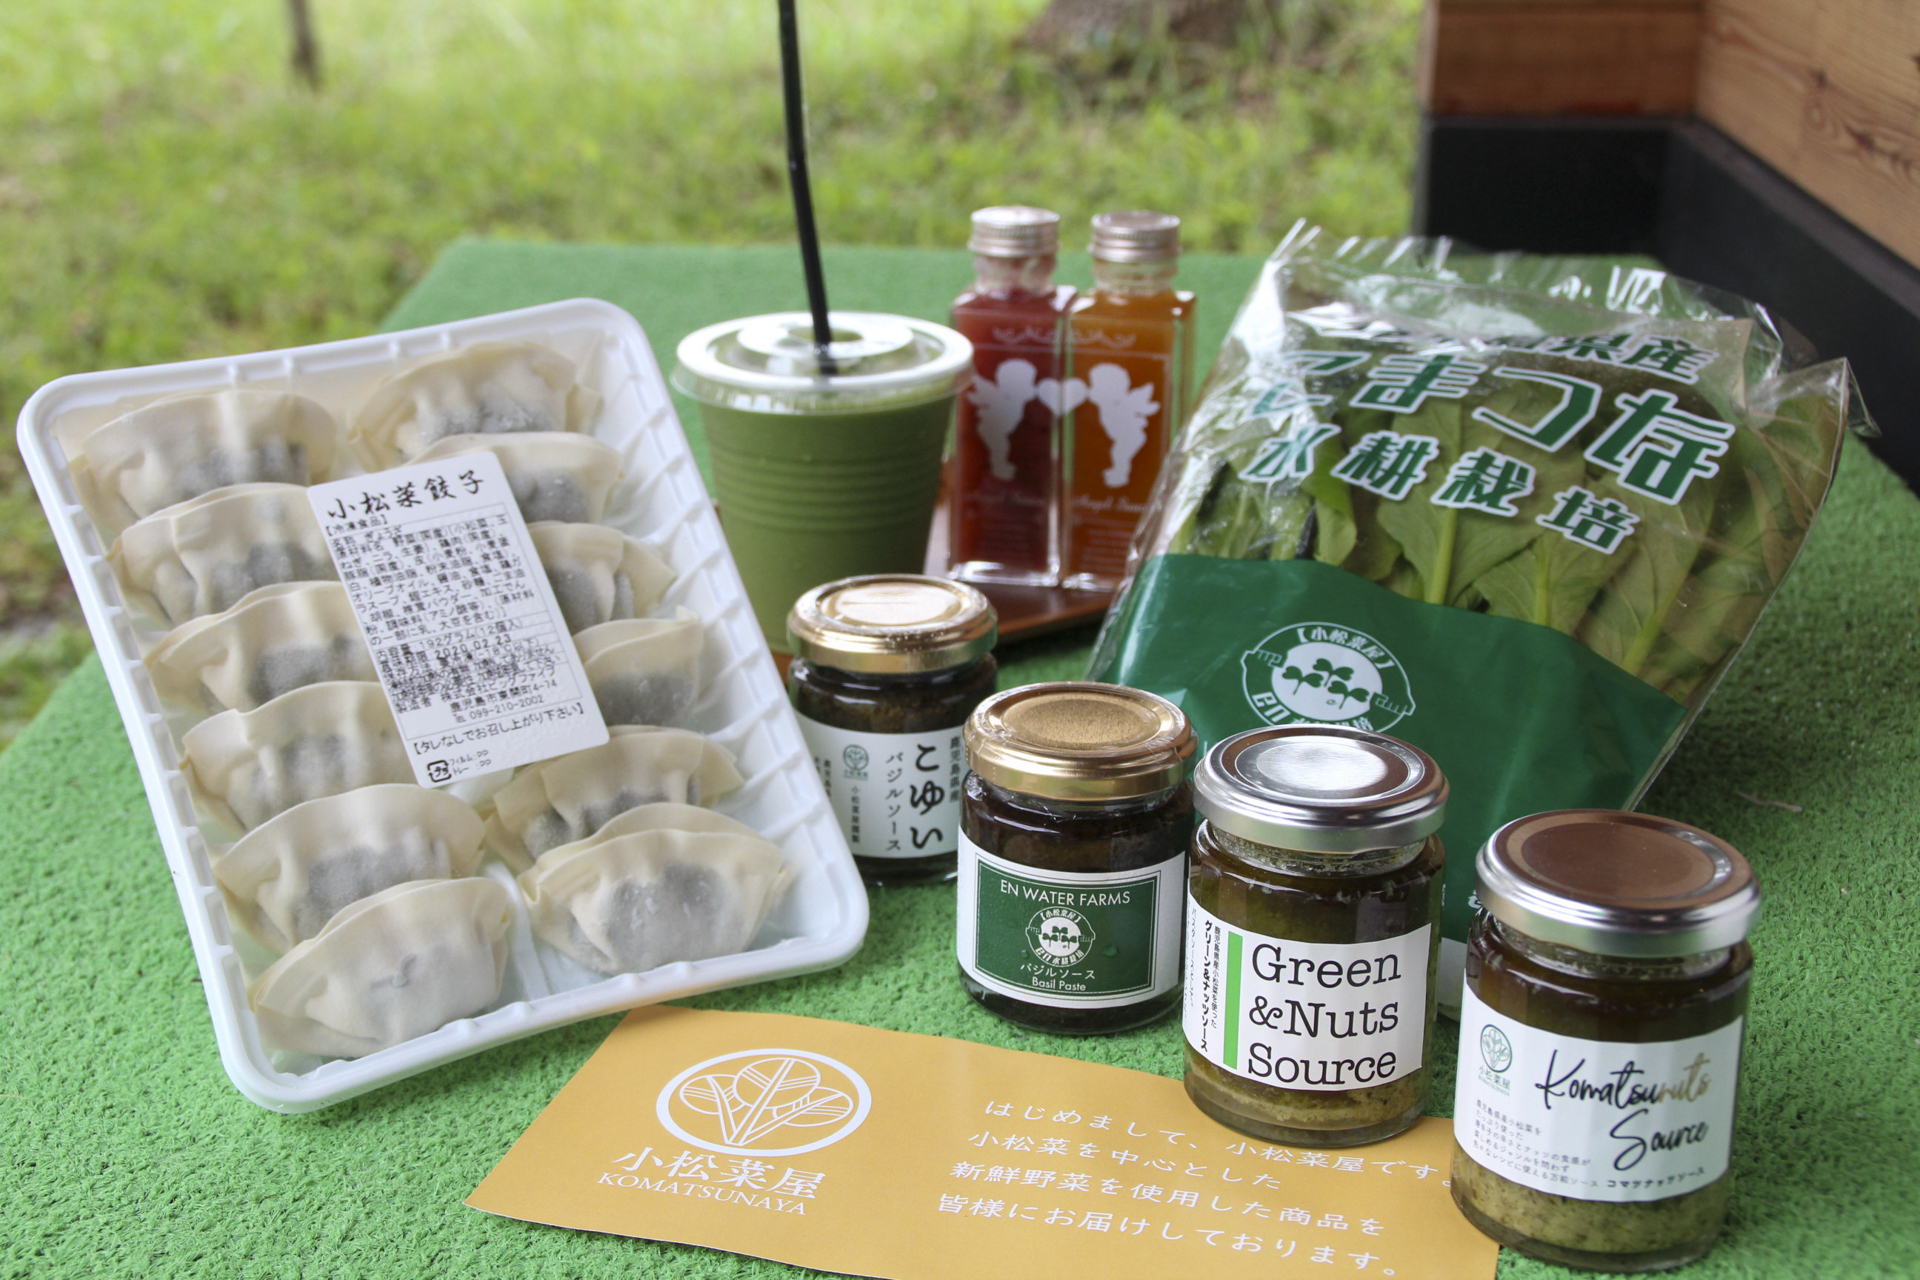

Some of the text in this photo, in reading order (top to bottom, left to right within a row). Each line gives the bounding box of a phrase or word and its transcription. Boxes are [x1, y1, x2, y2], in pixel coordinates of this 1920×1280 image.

[1249, 349, 1736, 506] こまつな
[326, 470, 485, 519] 小松菜餃子
[1240, 423, 1641, 555] 水耕栽培
[325, 514, 388, 535] 【冷凍食品】
[412, 701, 584, 755] 【タレなしでお召し上がり下さい】
[468, 693, 544, 720] 099-210-2002
[886, 752, 904, 851] バジルソース
[910, 744, 945, 849] こゆい
[1000, 879, 1131, 906] EN WATER FARMS
[1020, 963, 1096, 980] バジルソース
[1032, 977, 1086, 992] Basil Paste
[1252, 943, 1402, 988] Green
[1249, 995, 1399, 1038] &Nuts
[1247, 1042, 1397, 1085] Source
[1534, 1049, 1711, 1110] Komatsunuts
[969, 1131, 1281, 1191] 小松菜を中心とした
[1609, 1108, 1709, 1171] Source
[597, 1172, 806, 1216] KOMATSUNAYA
[612, 1146, 825, 1199] 小松菜屋
[949, 1160, 1385, 1237] 新鮮野菜を使用した商品を
[937, 1193, 1396, 1277] 皆様にお届けしております。
